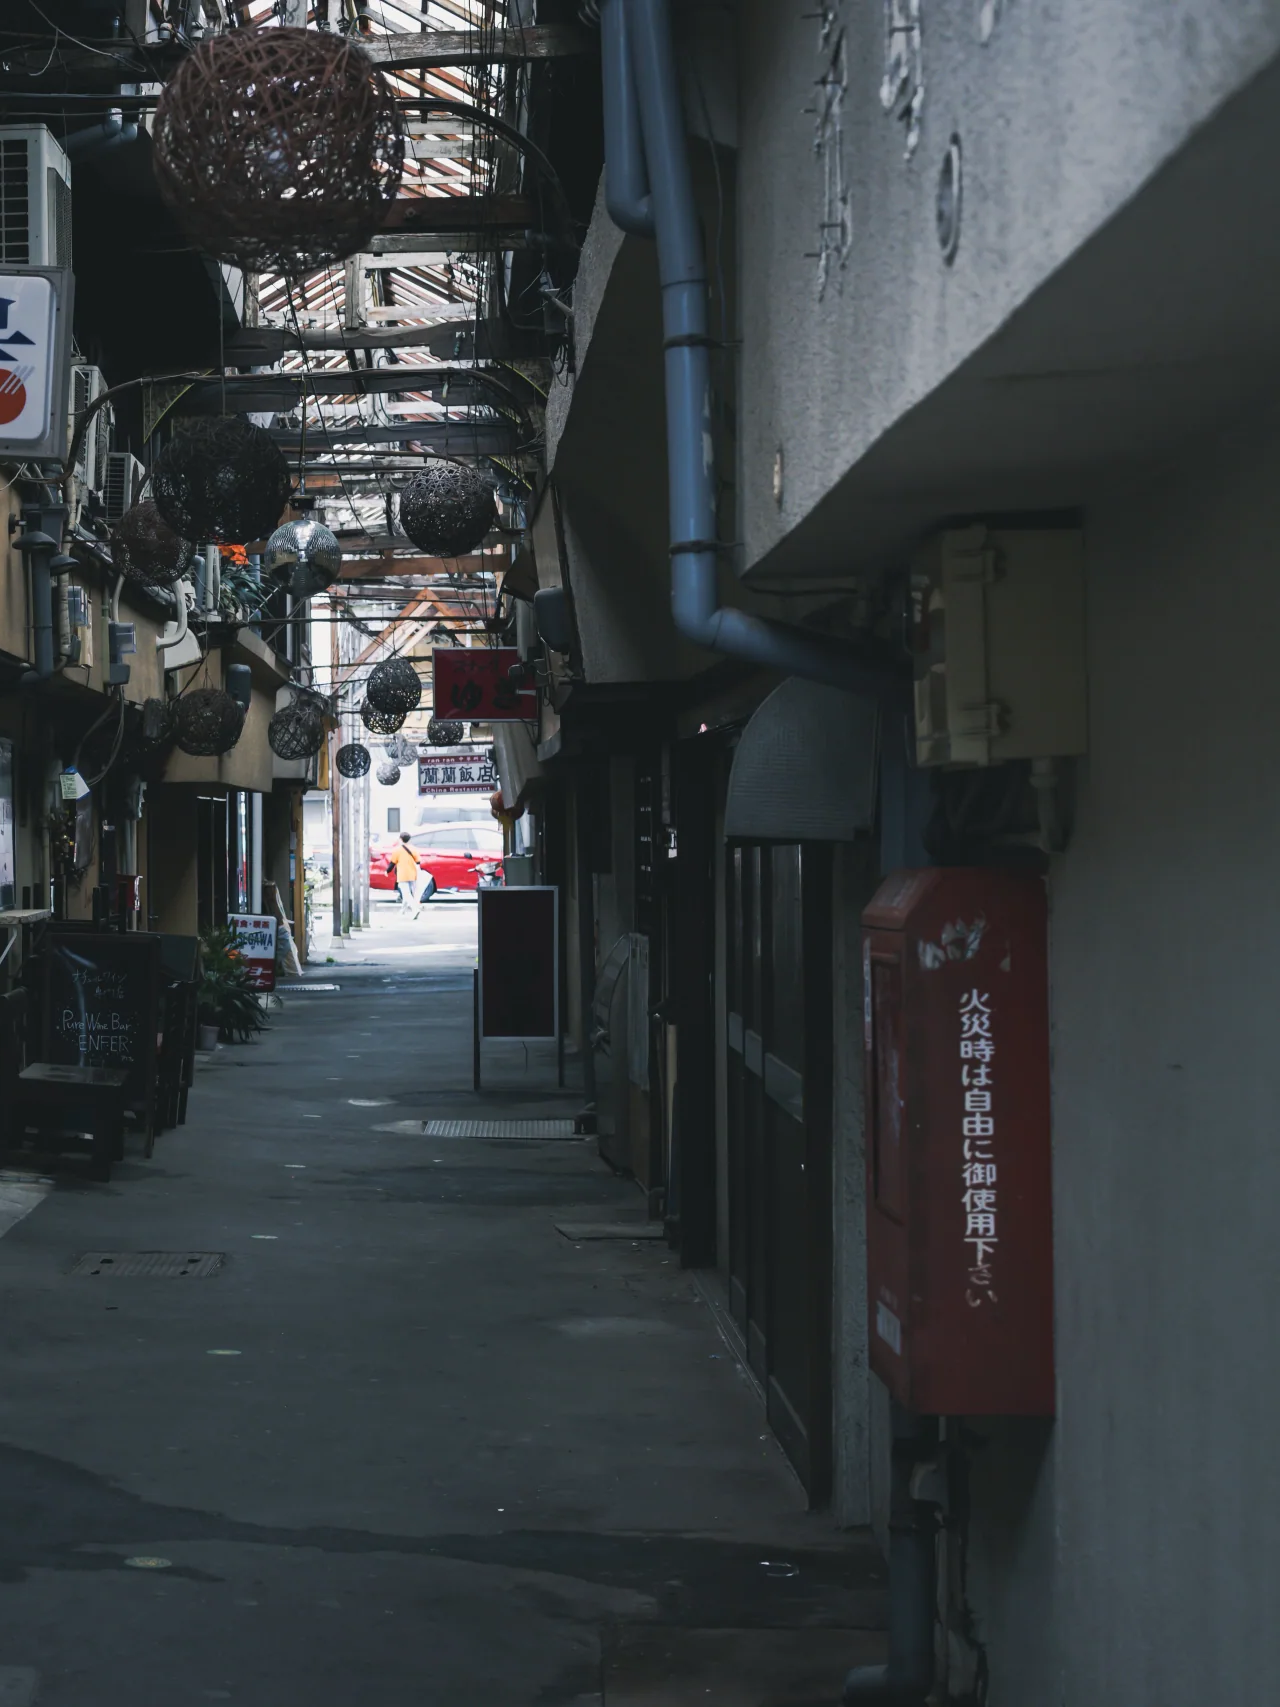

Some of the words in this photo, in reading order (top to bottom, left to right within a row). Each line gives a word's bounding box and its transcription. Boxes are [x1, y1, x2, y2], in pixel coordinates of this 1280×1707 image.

[229, 932, 273, 946] SEGAWA
[62, 1009, 85, 1031] Pure
[85, 1012, 108, 1031] Wine
[111, 1012, 132, 1031] Bar
[78, 1034, 129, 1053] ENFER
[959, 988, 999, 1307] 火災時は自由に御使用下さい
